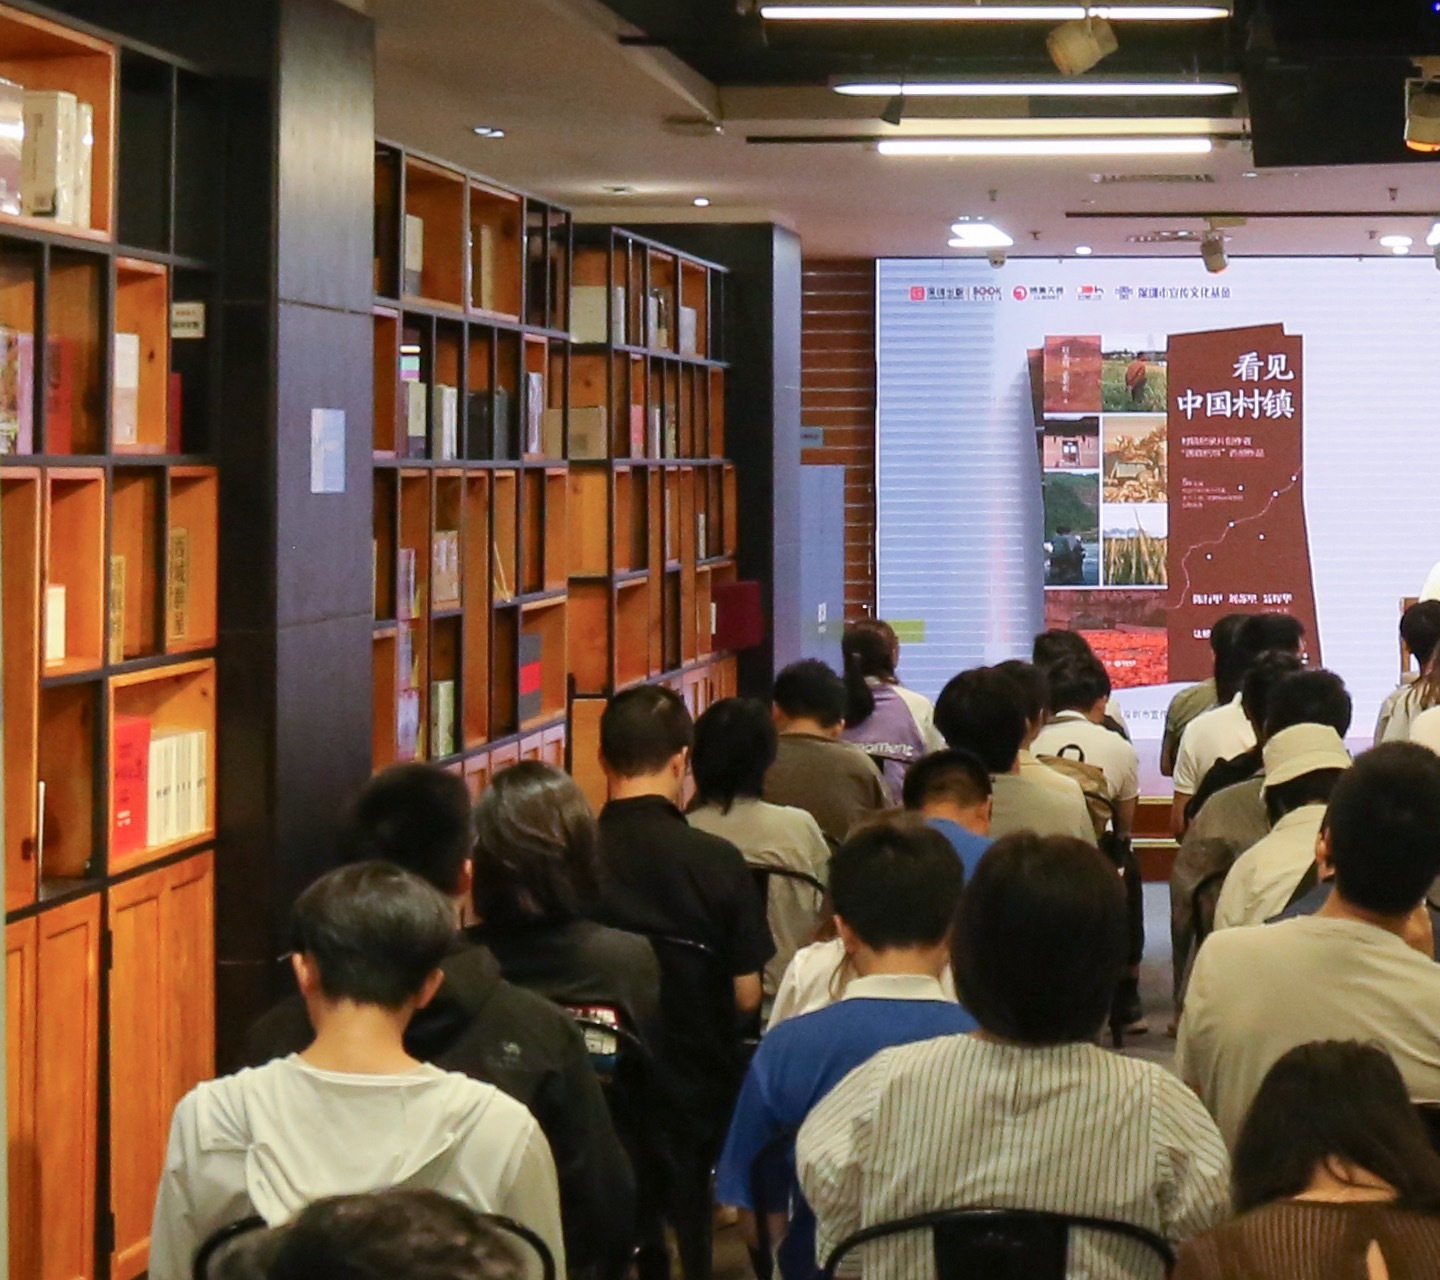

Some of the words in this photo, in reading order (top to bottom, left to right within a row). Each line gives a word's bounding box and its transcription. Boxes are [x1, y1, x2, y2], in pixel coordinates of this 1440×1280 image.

[1232, 352, 1295, 382] 看见
[1177, 388, 1295, 421] 中国村镇
